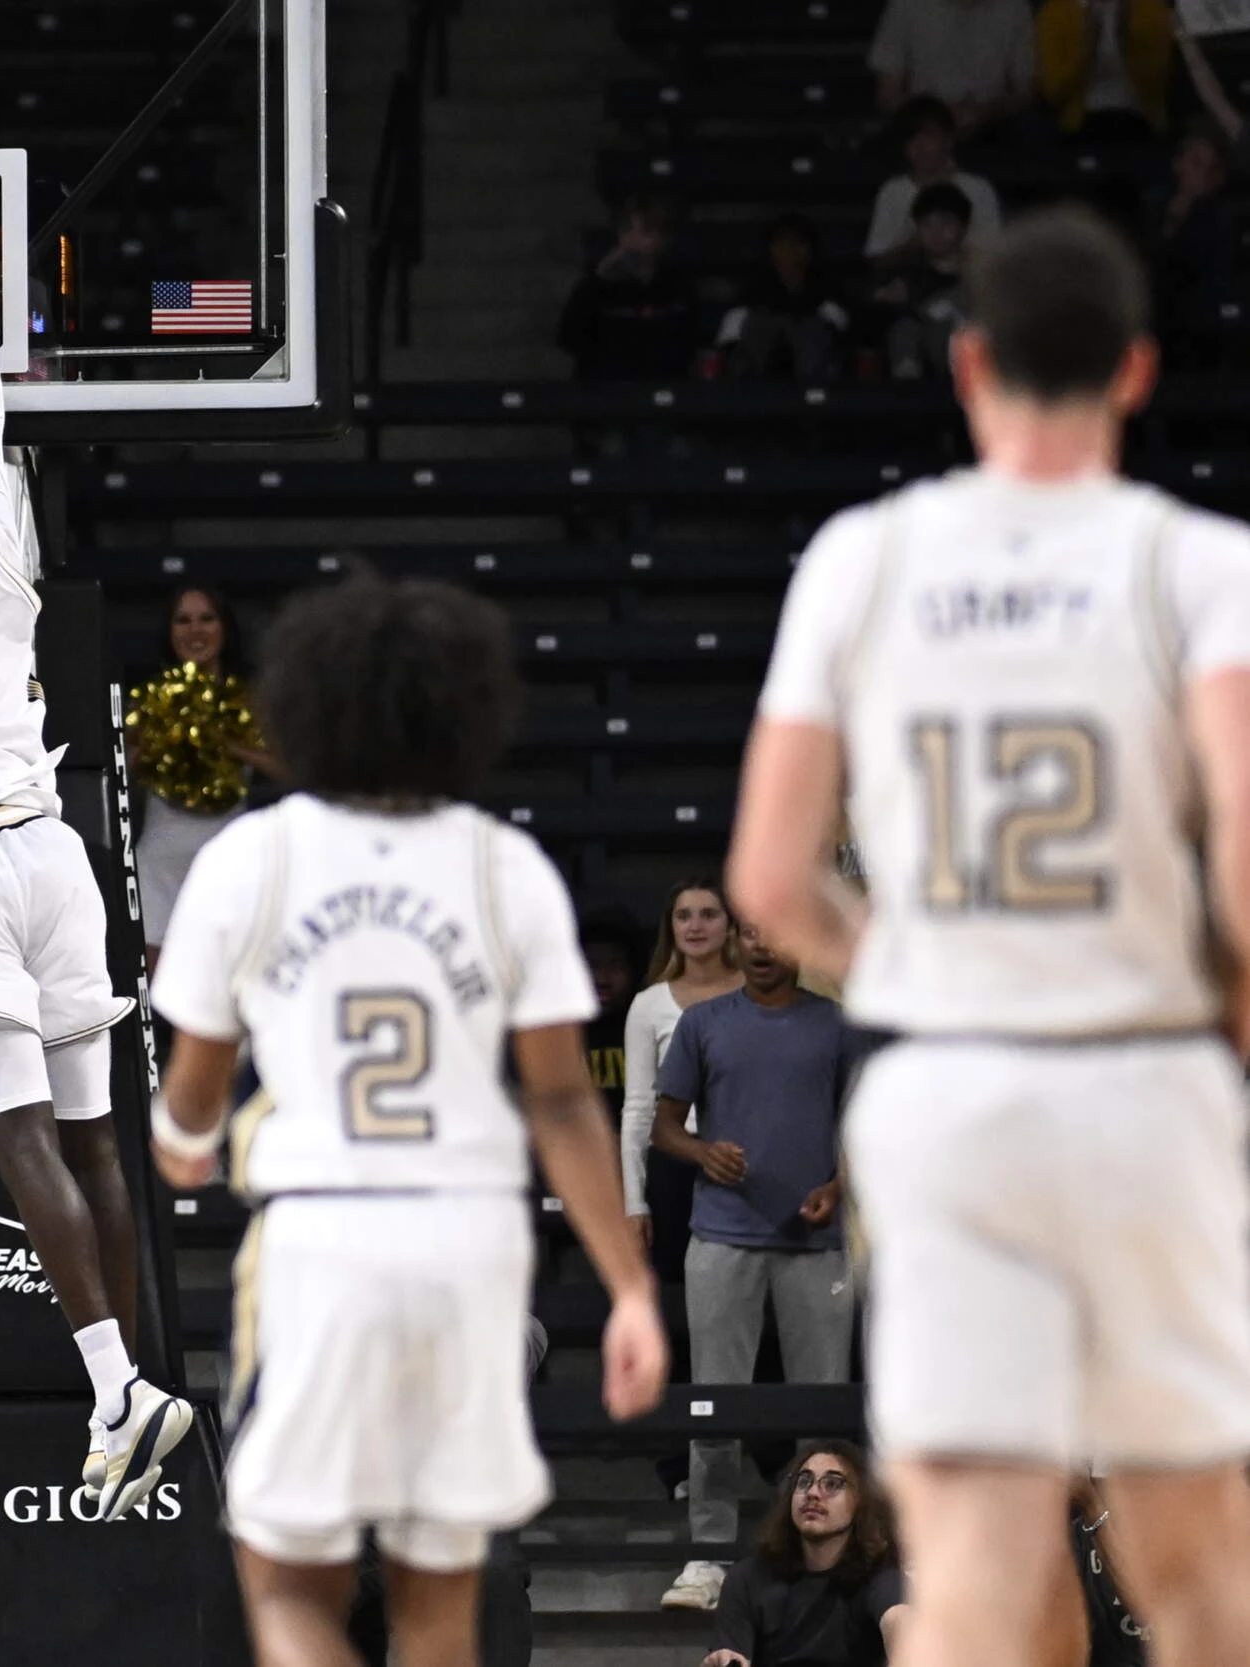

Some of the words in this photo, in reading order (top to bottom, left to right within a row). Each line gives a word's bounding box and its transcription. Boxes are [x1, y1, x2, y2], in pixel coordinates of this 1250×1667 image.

[110, 683, 140, 920] STING
[908, 713, 1112, 910] 12
[337, 986, 435, 1144] 2
